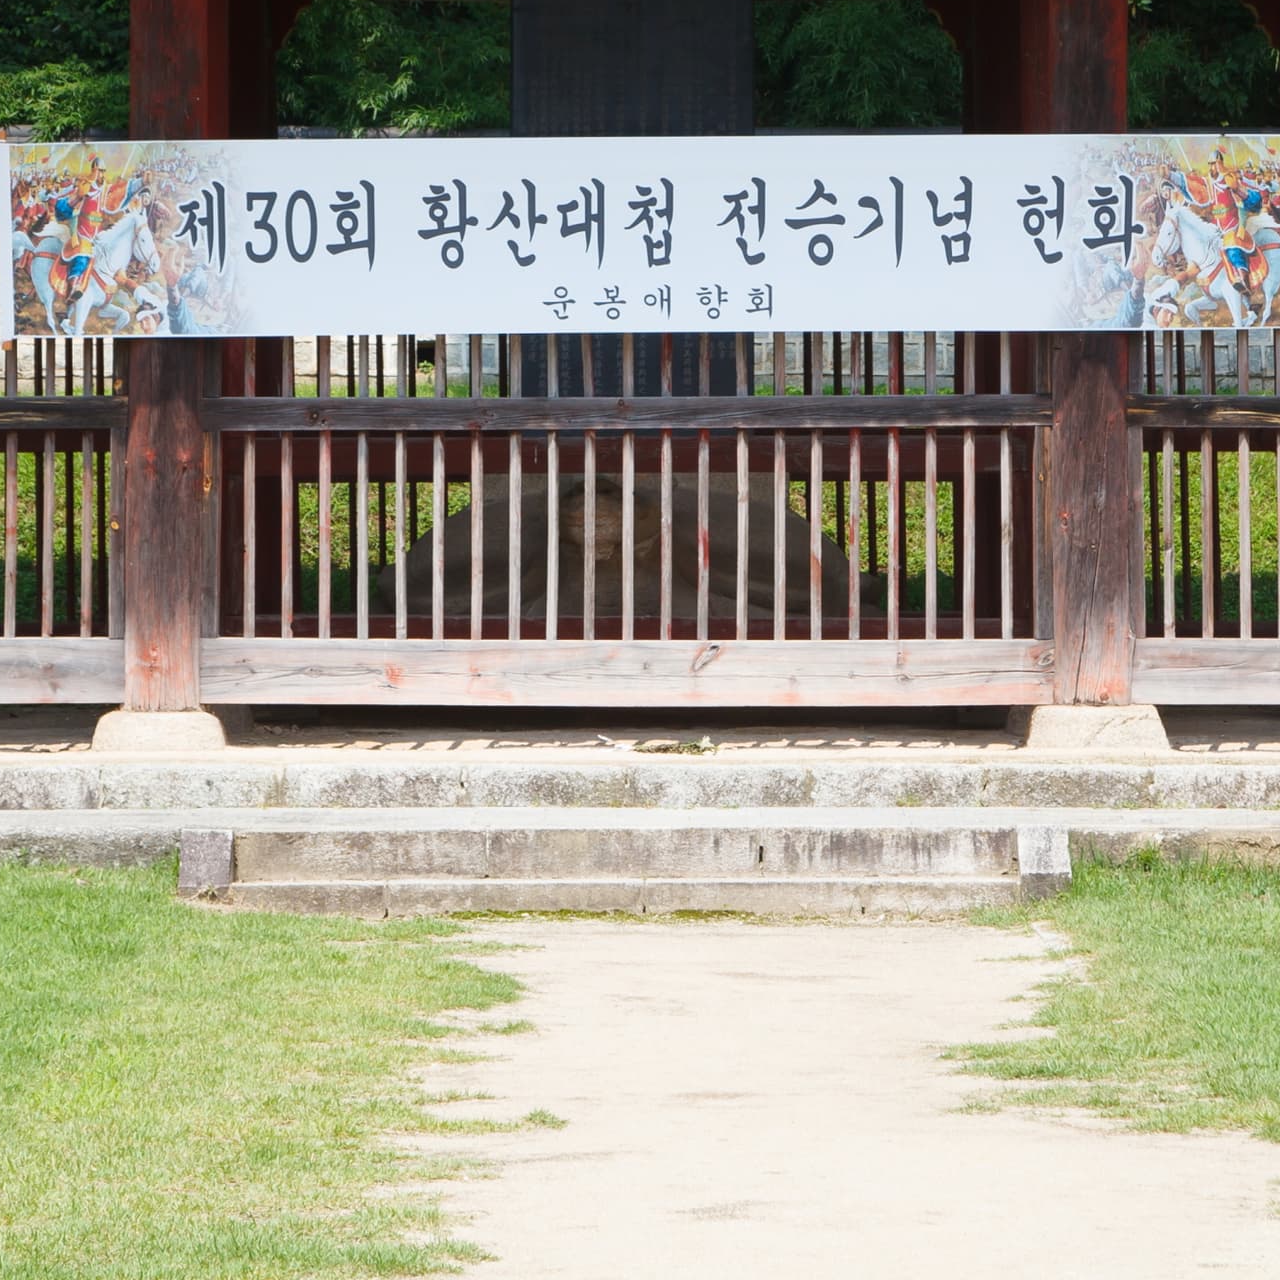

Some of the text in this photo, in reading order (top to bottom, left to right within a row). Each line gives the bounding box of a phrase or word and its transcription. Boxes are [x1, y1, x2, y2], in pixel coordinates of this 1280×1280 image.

[176, 175, 1144, 269] 제30회 황산대첩 전승기념 헌화
